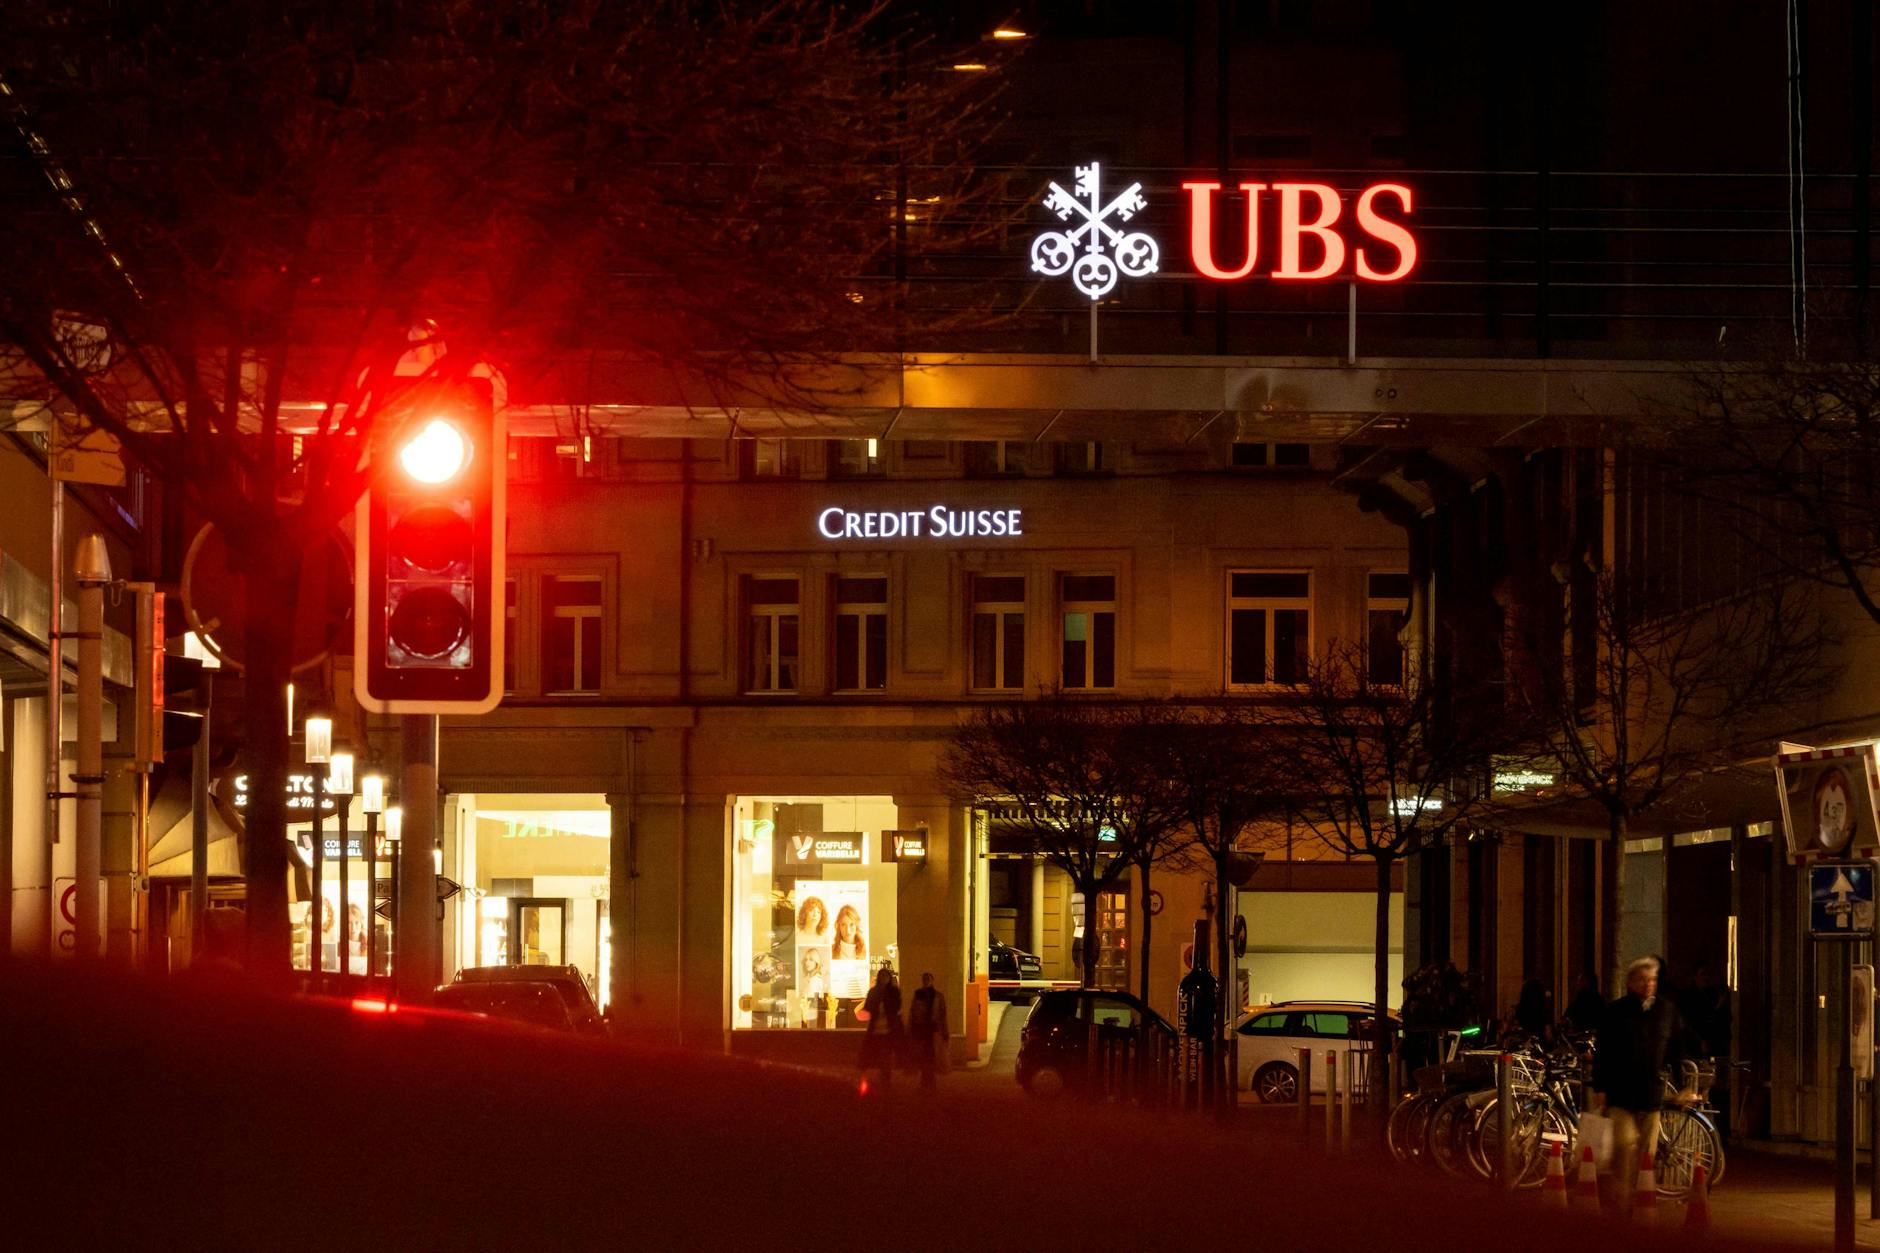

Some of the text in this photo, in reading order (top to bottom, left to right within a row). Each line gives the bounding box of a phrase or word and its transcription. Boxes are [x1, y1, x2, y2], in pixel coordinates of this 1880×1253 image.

[1182, 182, 1417, 281] UBS
[818, 505, 1022, 538] CREDIT SUISSE
[815, 841, 853, 849] COIFFURE
